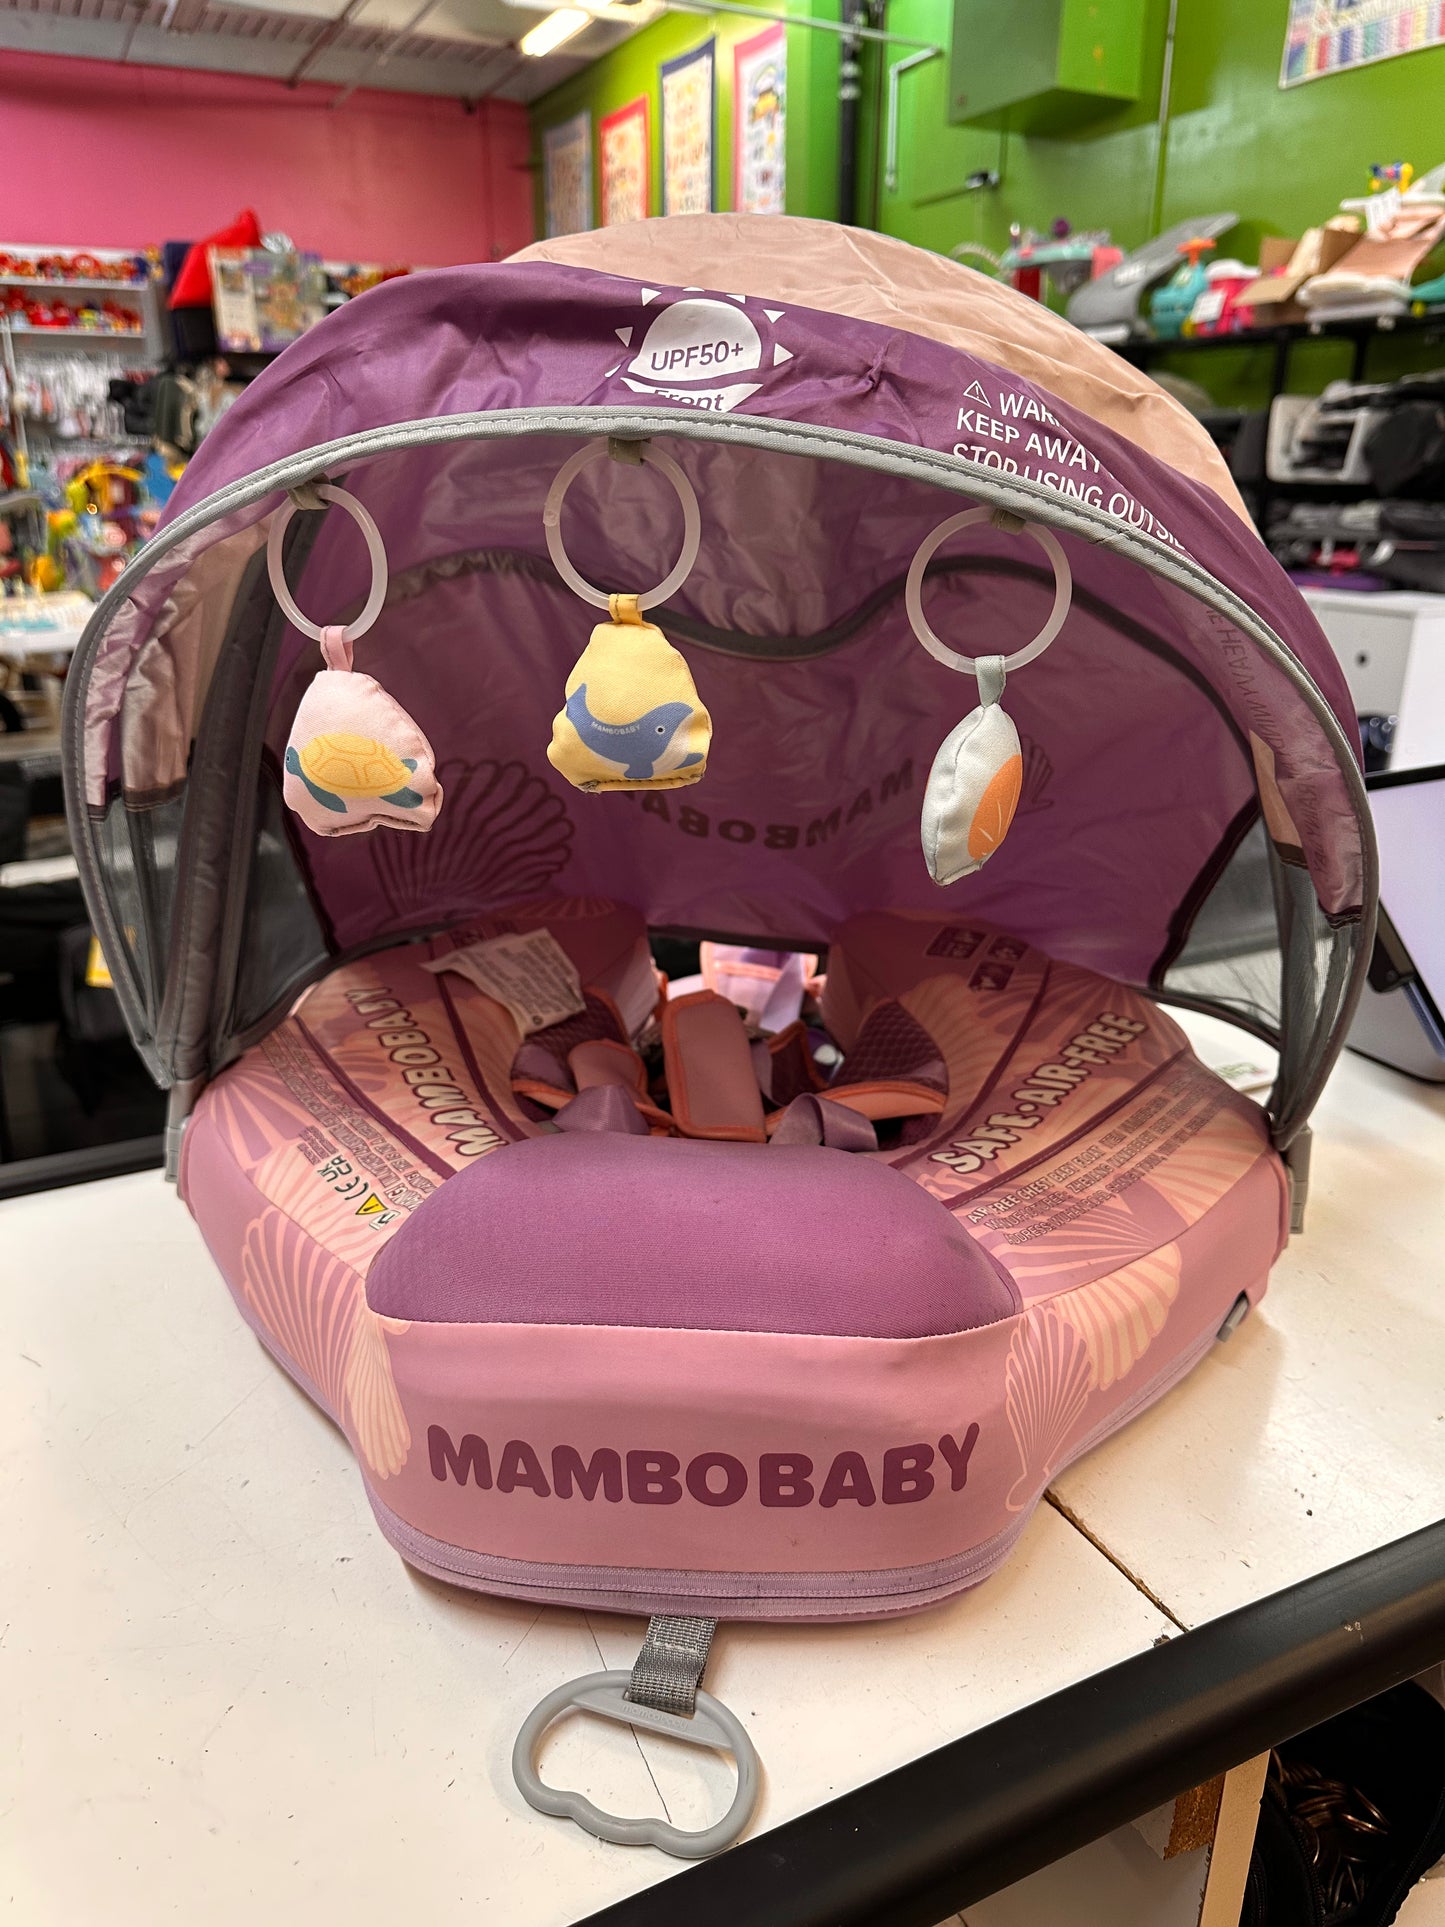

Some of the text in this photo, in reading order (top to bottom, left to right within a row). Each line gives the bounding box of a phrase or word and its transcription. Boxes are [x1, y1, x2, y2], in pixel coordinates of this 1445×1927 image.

[651, 341, 743, 371] UPF50+
[956, 408, 1020, 444] KEEP
[953, 443, 1018, 474] STOP
[1023, 465, 1104, 508] USING
[591, 721, 641, 736] MAMBOBABY
[990, 1194, 1020, 1215] FREE
[1016, 1176, 1054, 1201] CHEST
